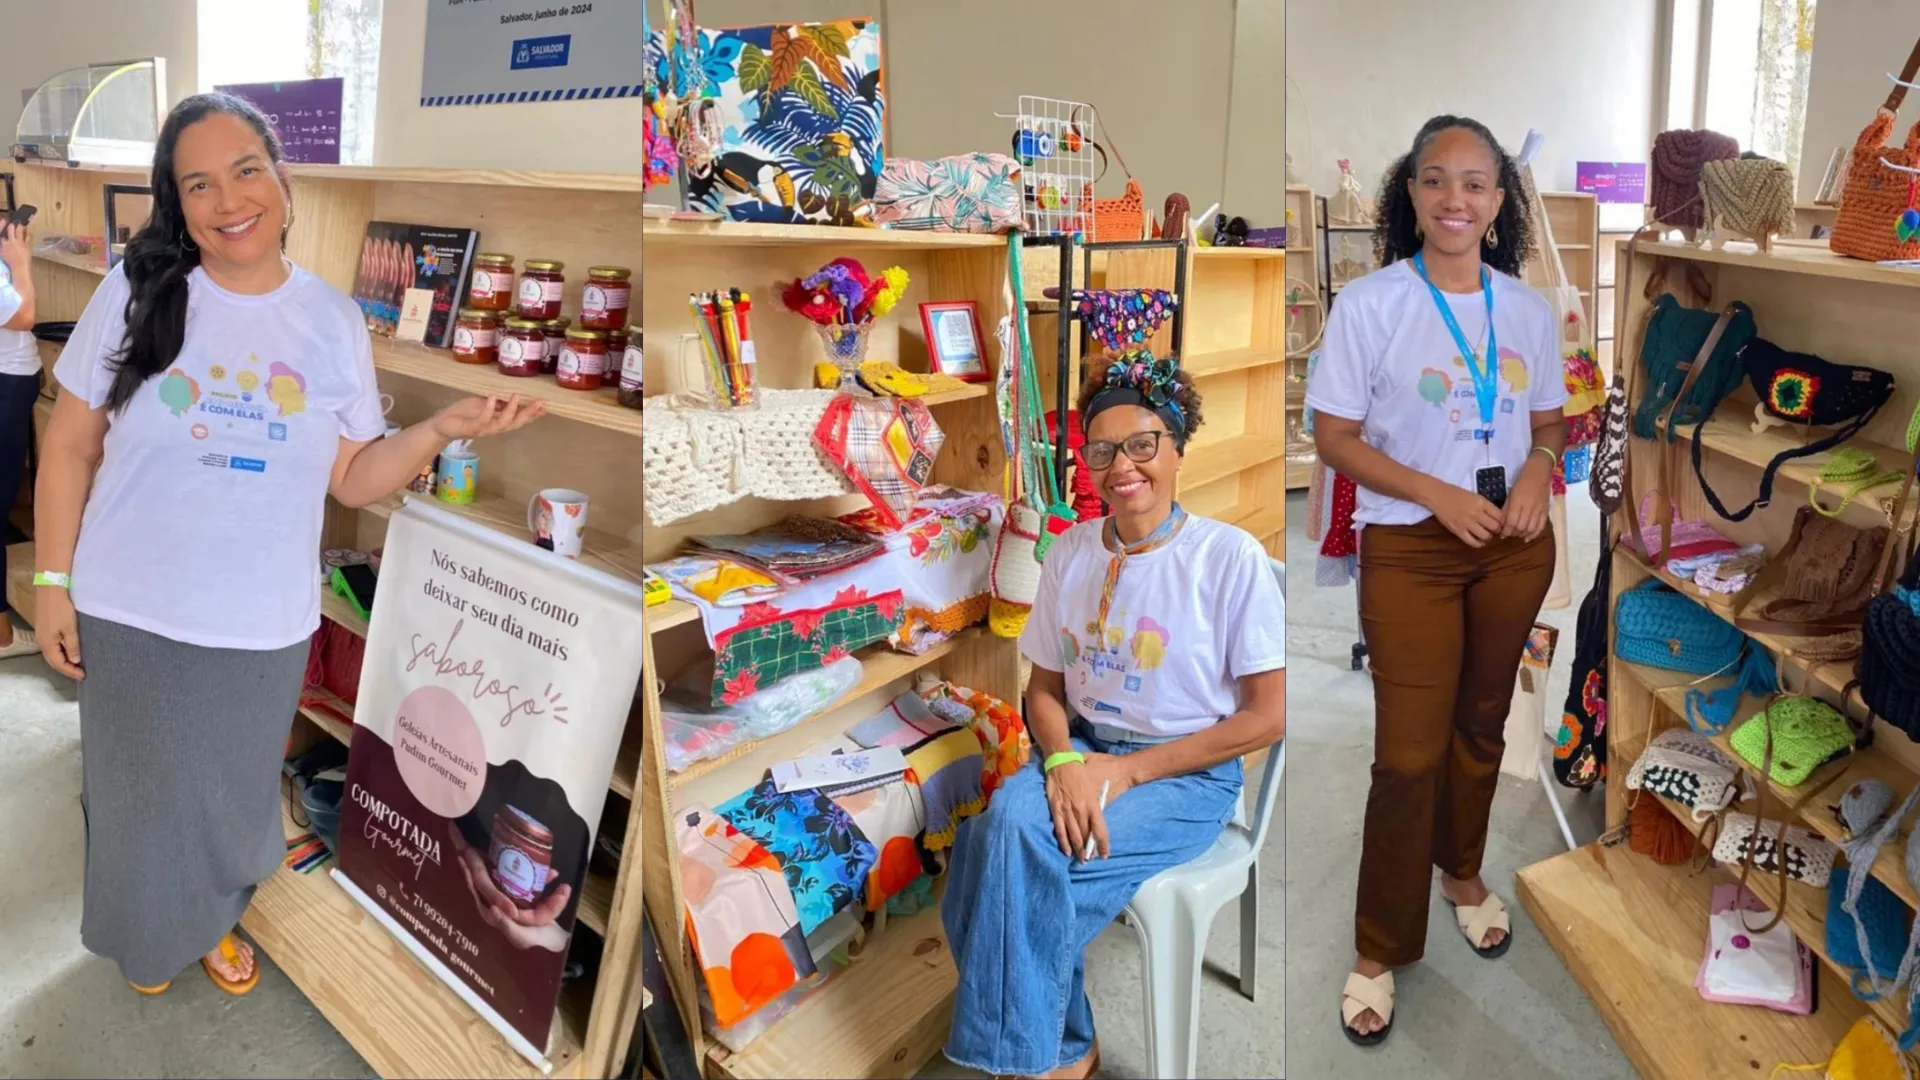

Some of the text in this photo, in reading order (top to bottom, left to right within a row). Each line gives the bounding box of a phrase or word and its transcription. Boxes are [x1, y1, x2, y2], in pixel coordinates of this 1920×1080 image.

[500, 3, 592, 25] Salvador, junho de 2024
[531, 43, 564, 55] SALVADOR
[208, 405, 234, 416] COM
[236, 409, 264, 420] ELAS
[423, 578, 569, 661] deixar seu dia mais
[431, 549, 579, 628] Nós sabemos como
[406, 618, 545, 727] saboroso
[399, 716, 479, 776] Geleias Artesanais
[401, 738, 468, 791] Pudim Gourmet
[351, 783, 441, 862] COMPOTADA
[364, 811, 441, 881] Gourmet
